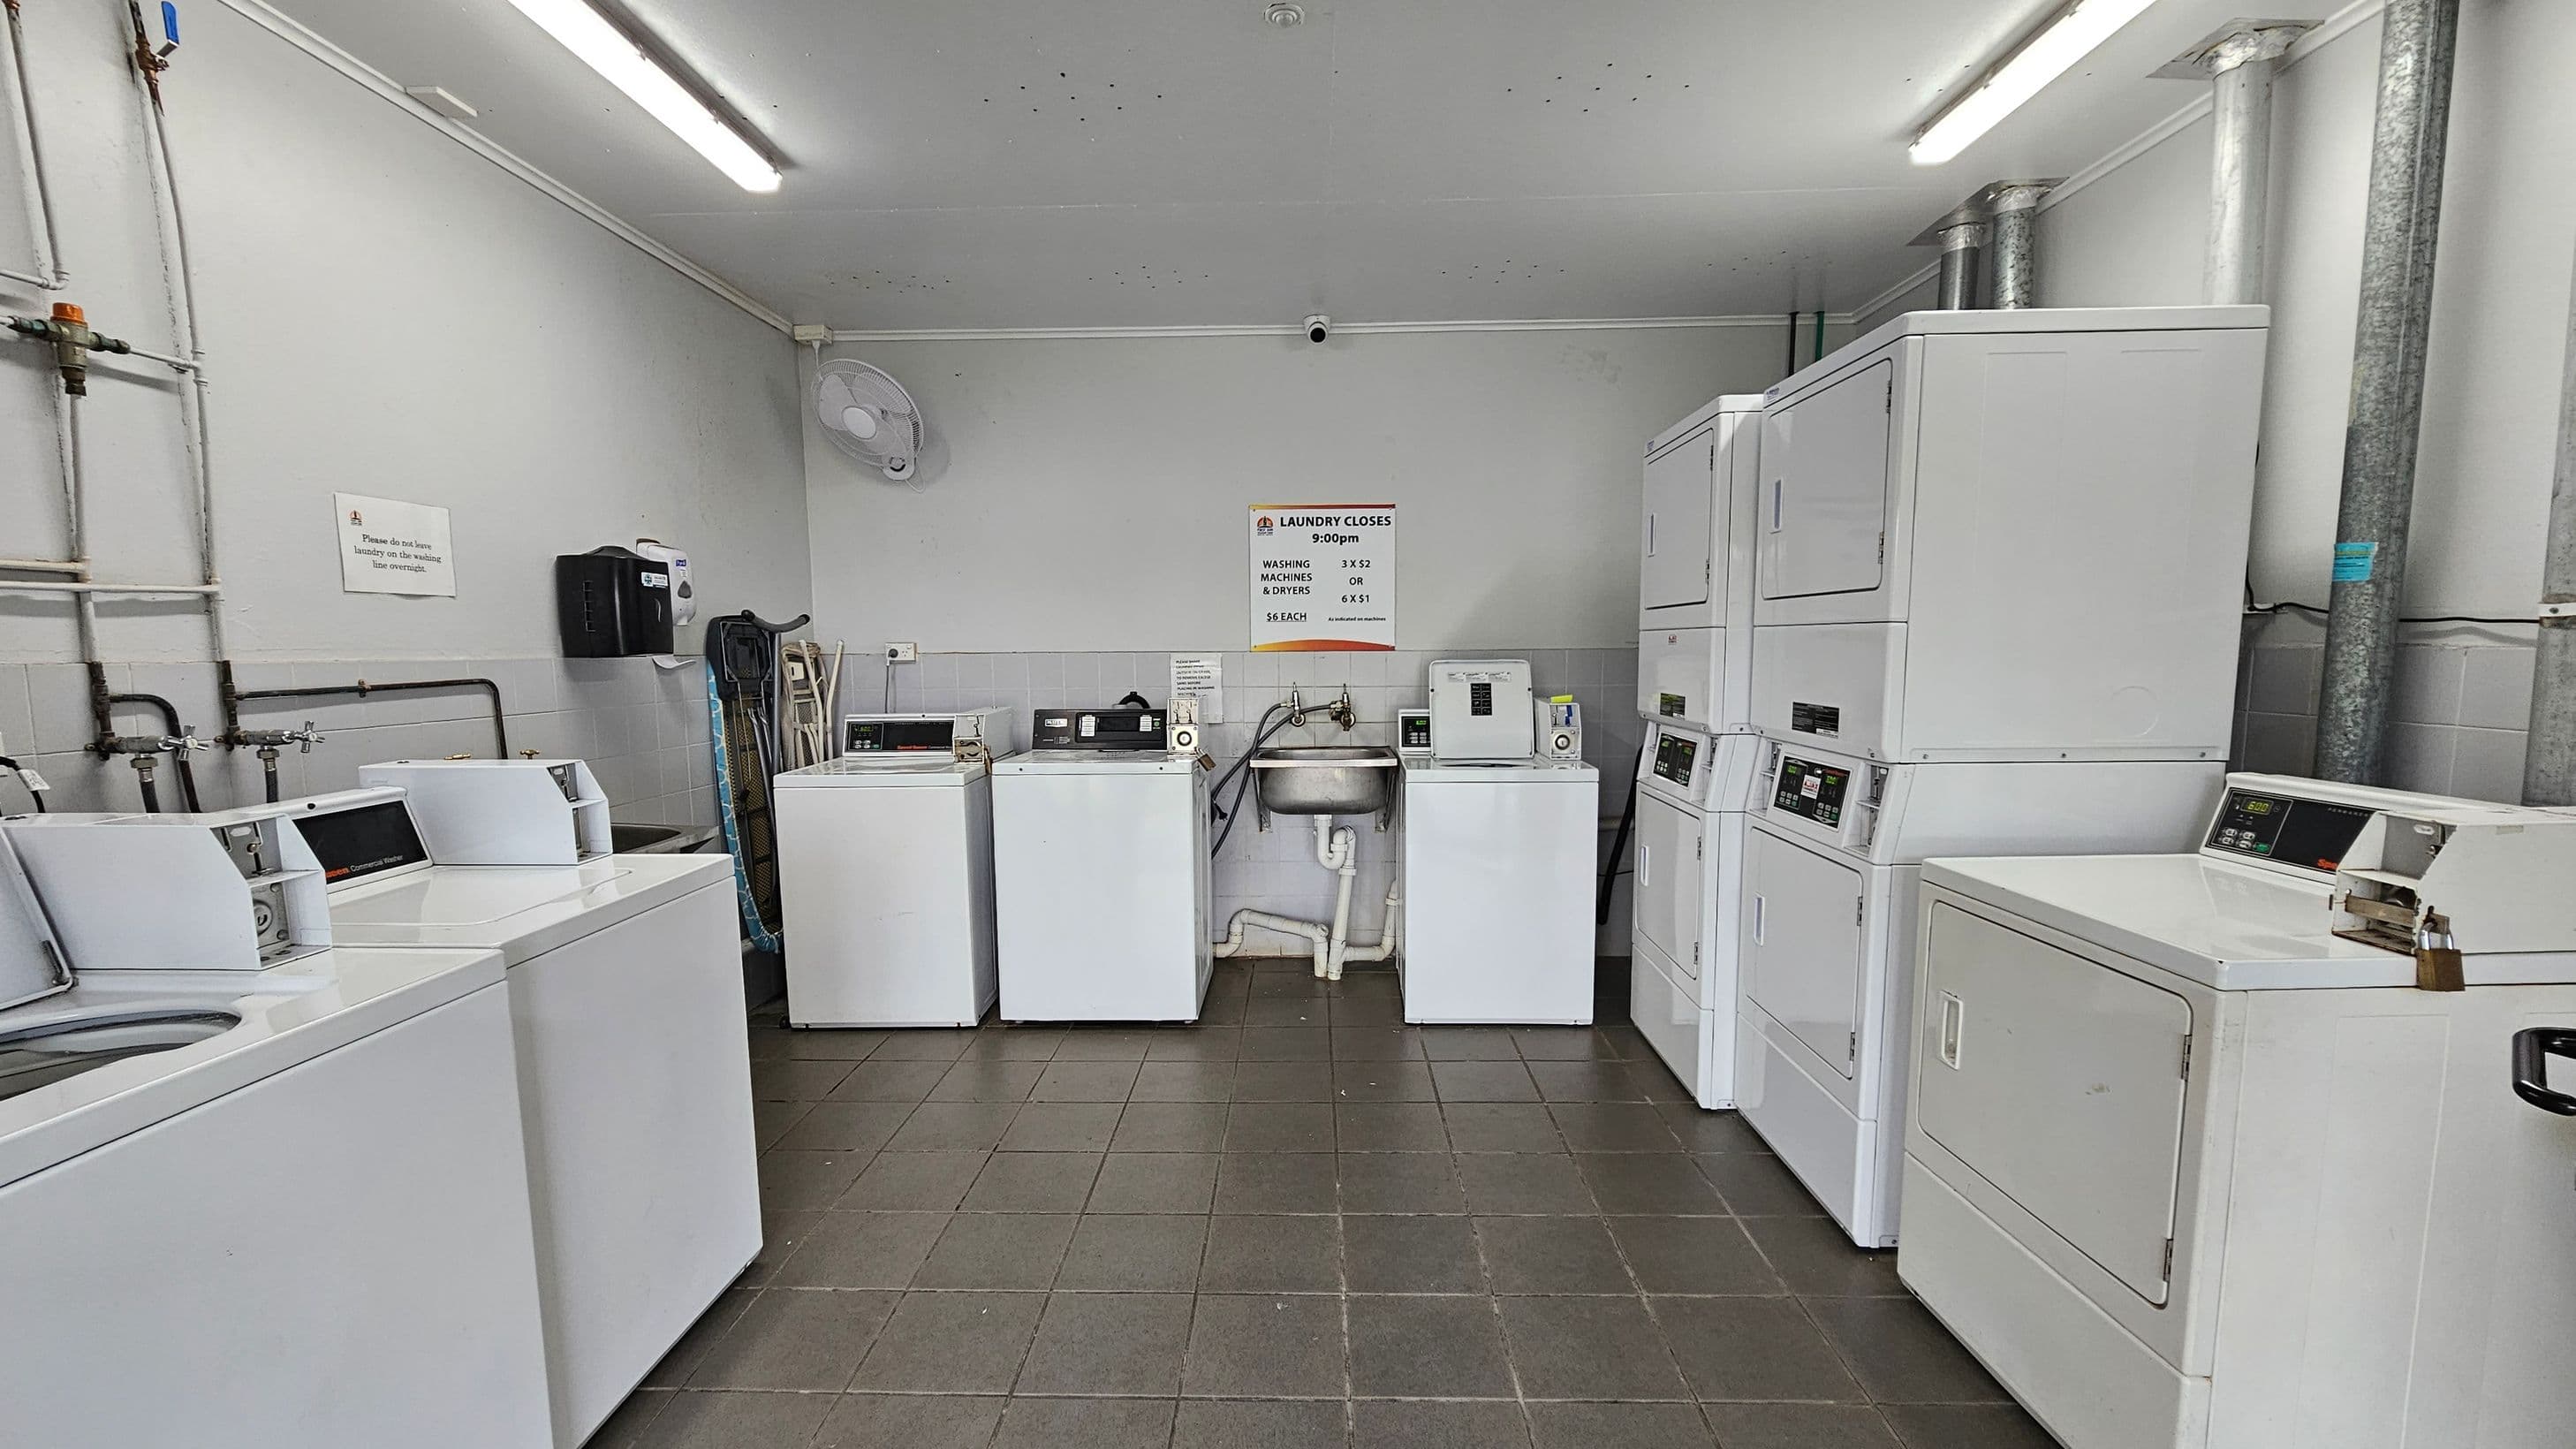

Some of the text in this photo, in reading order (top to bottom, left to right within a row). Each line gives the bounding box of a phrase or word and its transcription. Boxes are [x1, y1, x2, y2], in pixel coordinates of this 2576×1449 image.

[1280, 516, 1391, 527] LAUNDRY CLOSES
[362, 534, 389, 545] Please
[390, 537, 400, 546] do
[415, 540, 432, 550] leave
[1312, 534, 1360, 545] 9:00pm
[353, 545, 385, 558] laundry
[399, 550, 413, 559] the
[413, 553, 442, 564] washing
[372, 560, 388, 570] line
[1262, 559, 1310, 569] WASHING
[1341, 559, 1371, 568] 3 X $2
[1261, 573, 1313, 581] MACHINES
[1349, 577, 1364, 586] OR
[1341, 594, 1369, 603] 6 X $1
[1266, 612, 1307, 622] $6 EACH
[325, 854, 404, 878] ueen Commercial Washer
[2317, 858, 2337, 870] Spe
